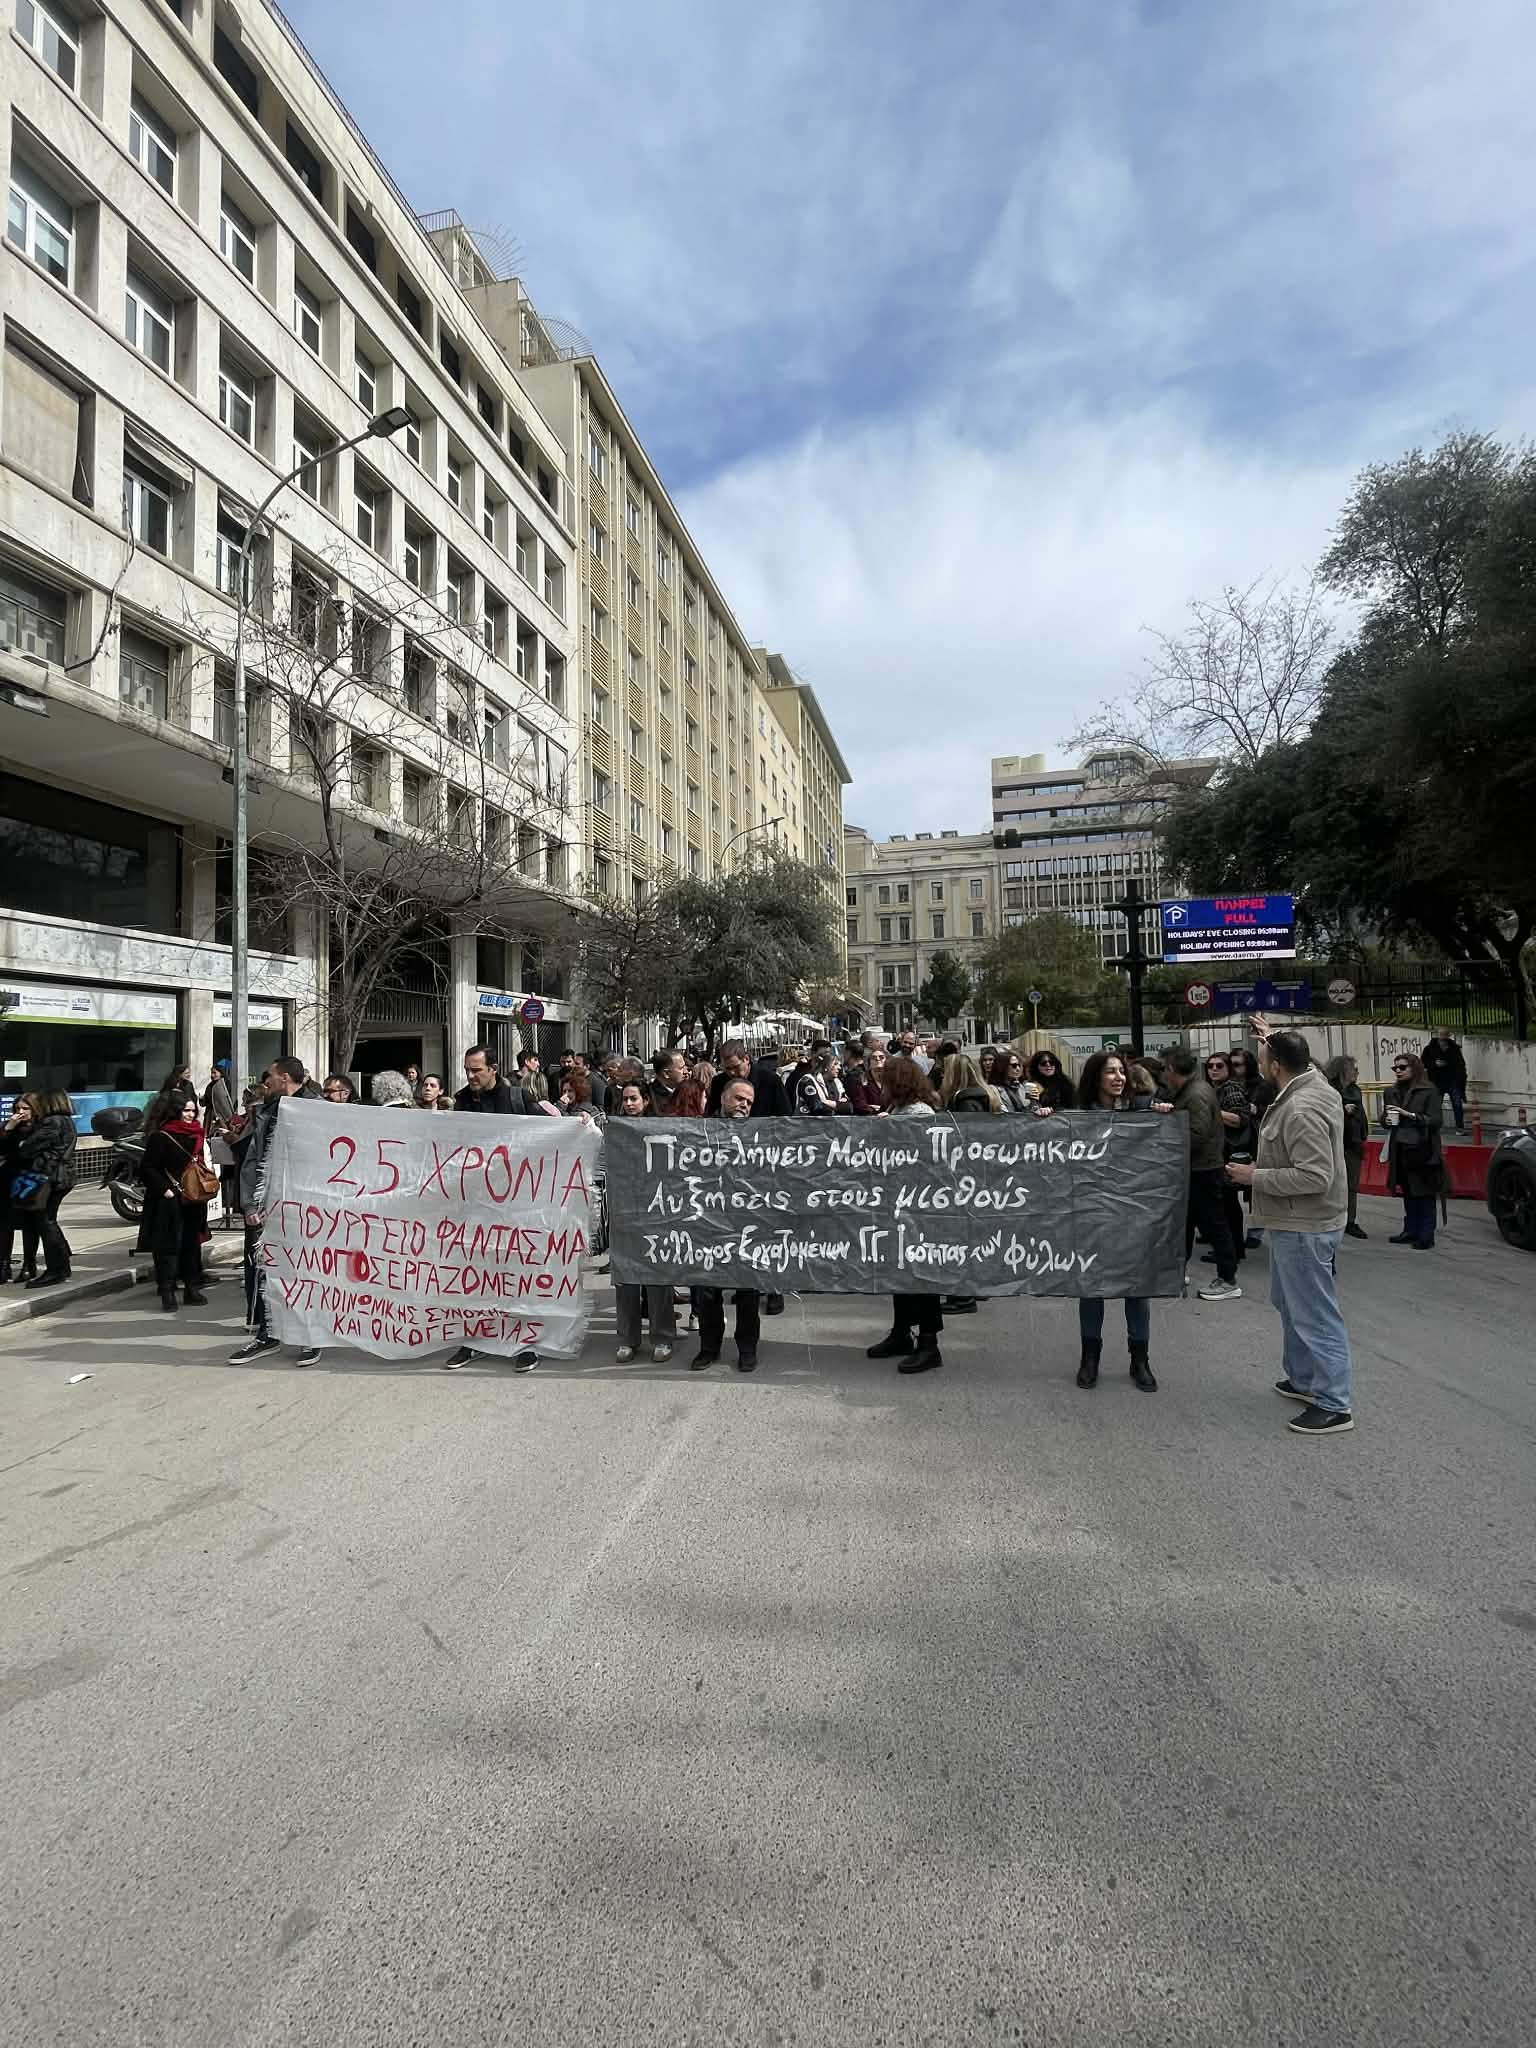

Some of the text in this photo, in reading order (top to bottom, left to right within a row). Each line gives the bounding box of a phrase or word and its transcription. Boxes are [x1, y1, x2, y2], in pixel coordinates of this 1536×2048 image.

[1171, 910, 1182, 924] P
[1206, 928, 1221, 937] EVE
[1222, 928, 1256, 936] CLOSING
[1224, 913, 1257, 925] FULL
[1180, 942, 1212, 951] HOLIDAY
[1212, 941, 1246, 949] OPENING
[643, 1131, 818, 1173] Προσλήψεις
[926, 1126, 1113, 1172] Προσωπικού
[327, 1136, 589, 1208] 2,5 ΧΡΟΝΙΑ
[647, 1175, 1030, 1222] Αυξήσεις στους μισθούς
[436, 1216, 586, 1266] ΦΑΝΤΑΣΜΑ
[643, 1230, 737, 1270] Σύλλογος
[738, 1225, 851, 1273] Εργαζομένων
[897, 1224, 969, 1270] Ισότητας
[970, 1229, 1002, 1263] των
[333, 1314, 544, 1346] ΚΑΙ ΟΙΚΟΓΕΝΕΙΑΣ
